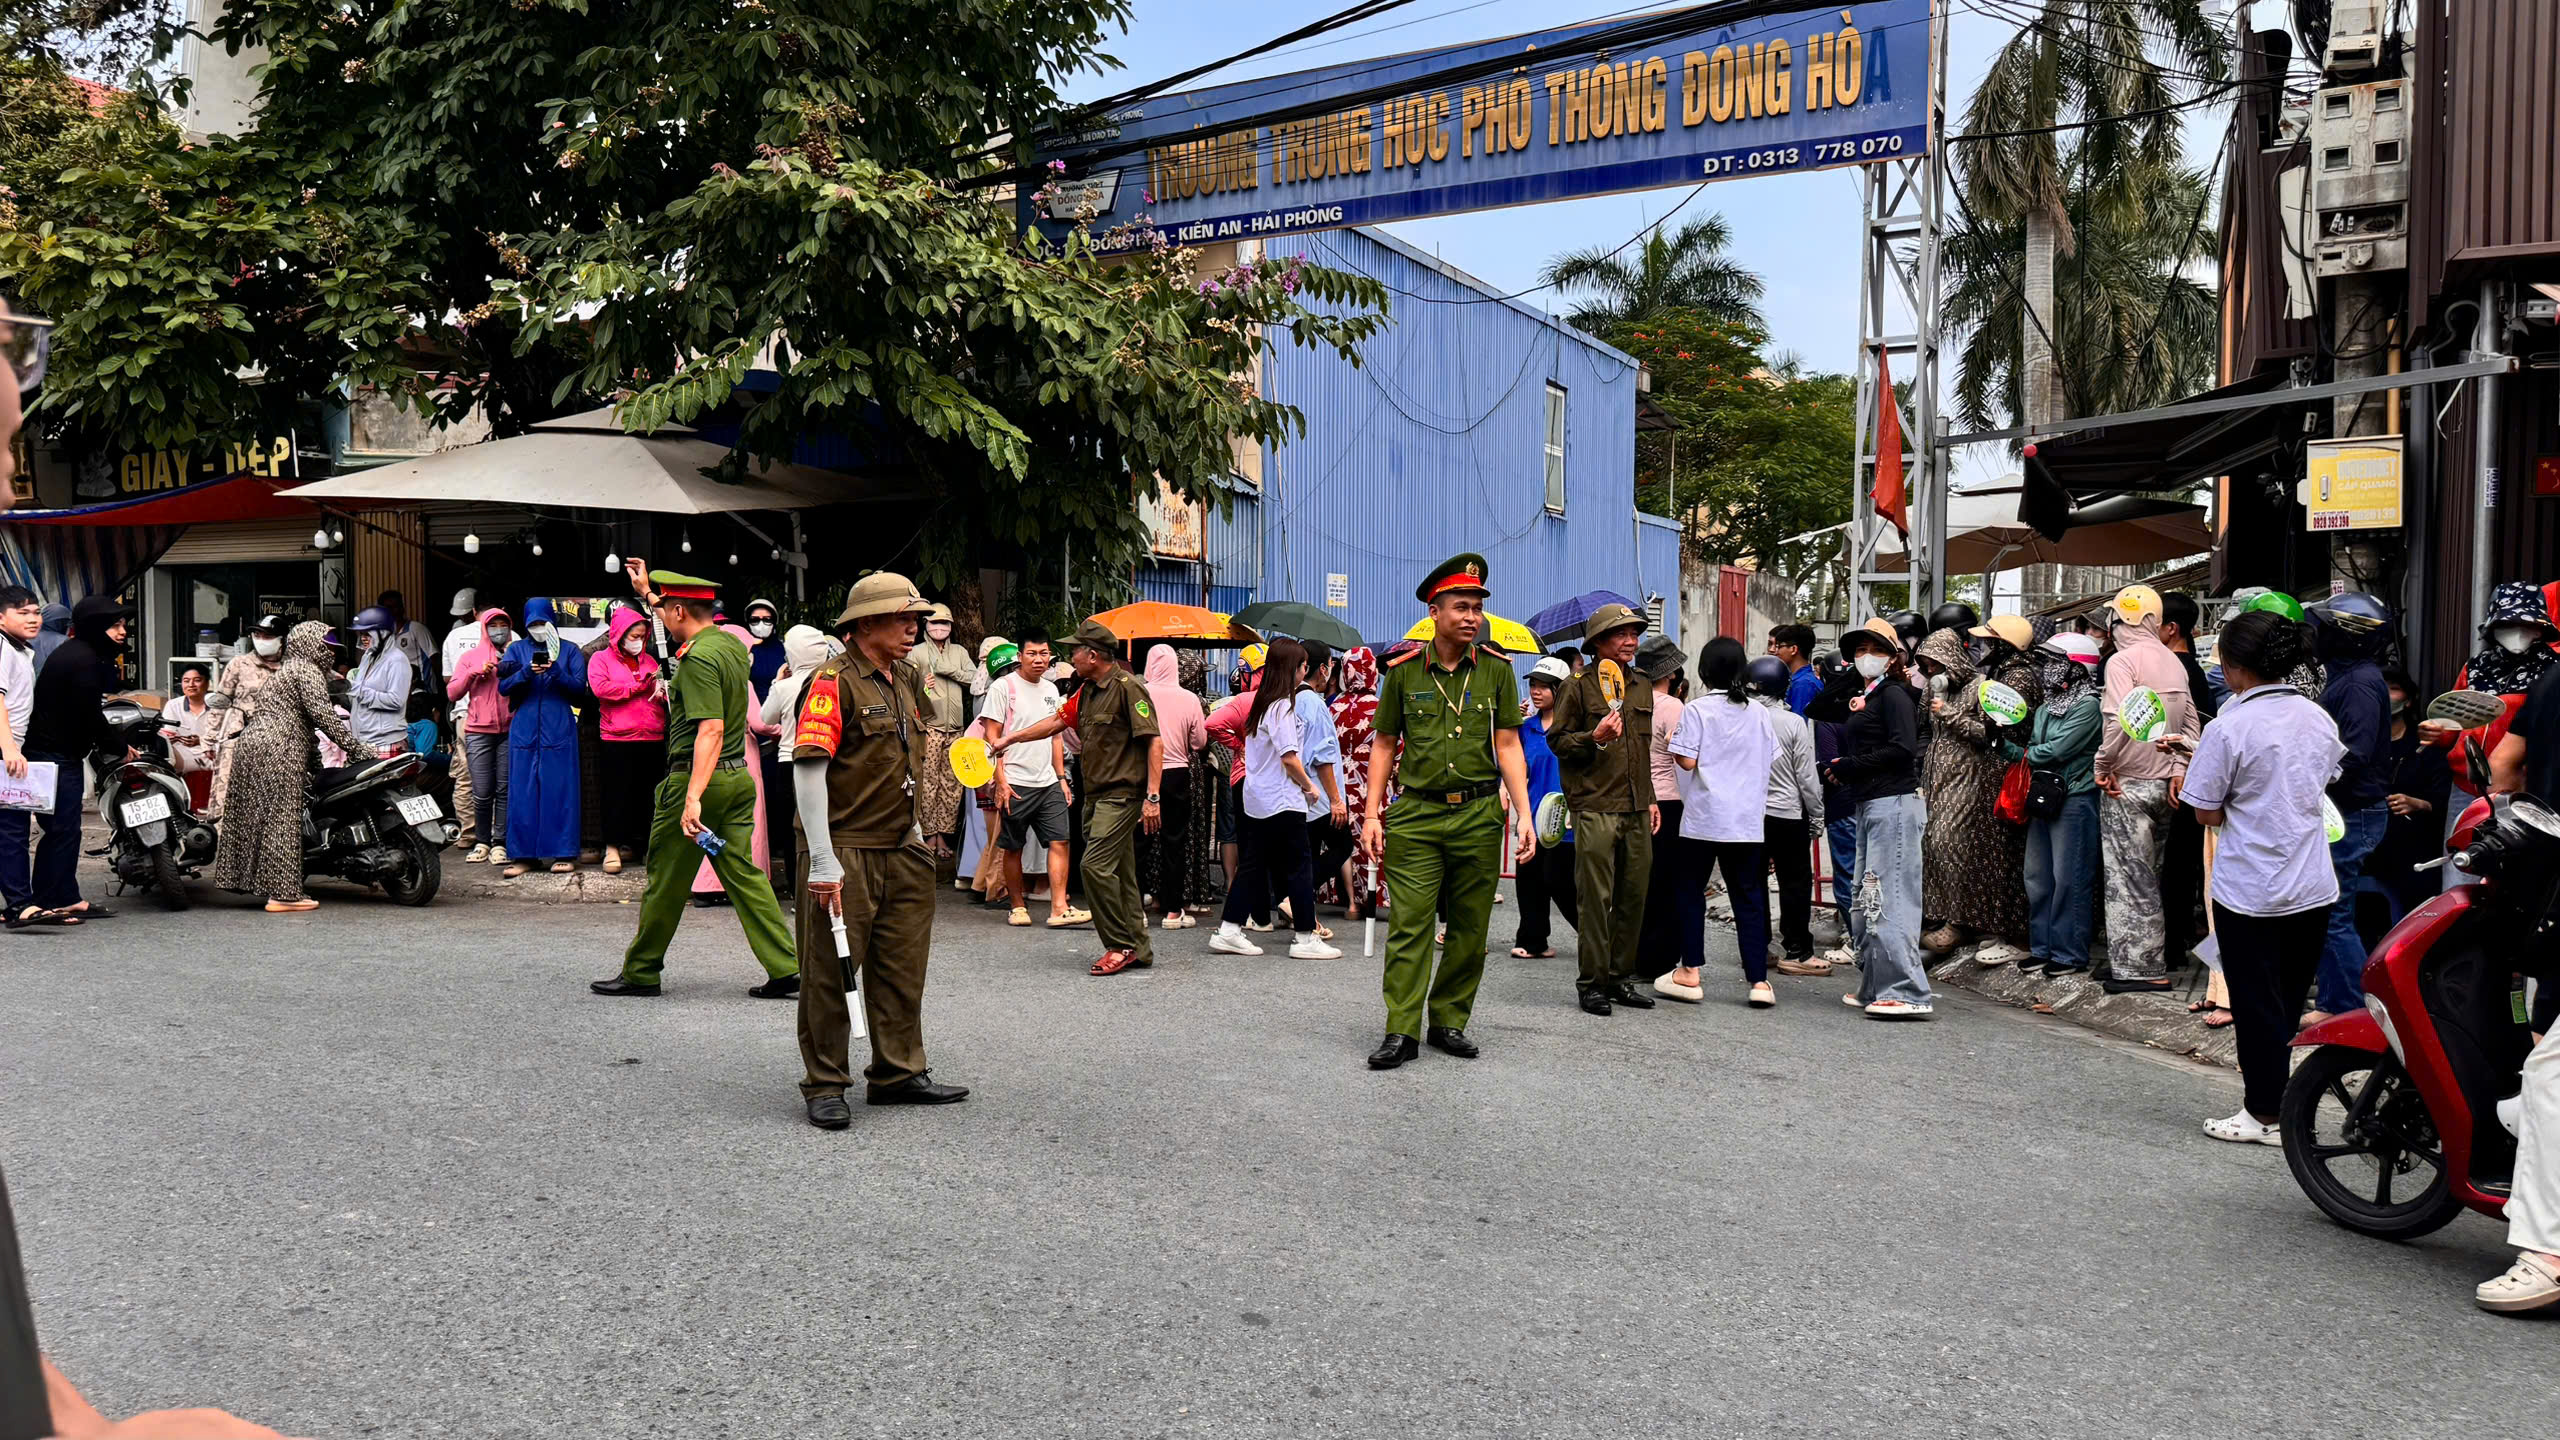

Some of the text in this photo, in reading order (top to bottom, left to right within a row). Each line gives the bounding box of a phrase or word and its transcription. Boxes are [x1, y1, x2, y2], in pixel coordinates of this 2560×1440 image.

[1269, 106, 1371, 184] TRUNG
[1545, 49, 1667, 146] THÔNG
[1814, 141, 1856, 161] 778
[1861, 134, 1903, 155] 070
[1179, 217, 1213, 241] KIẾN
[1285, 204, 1343, 228] PHÒNG
[991, 655, 1007, 667] Grab
